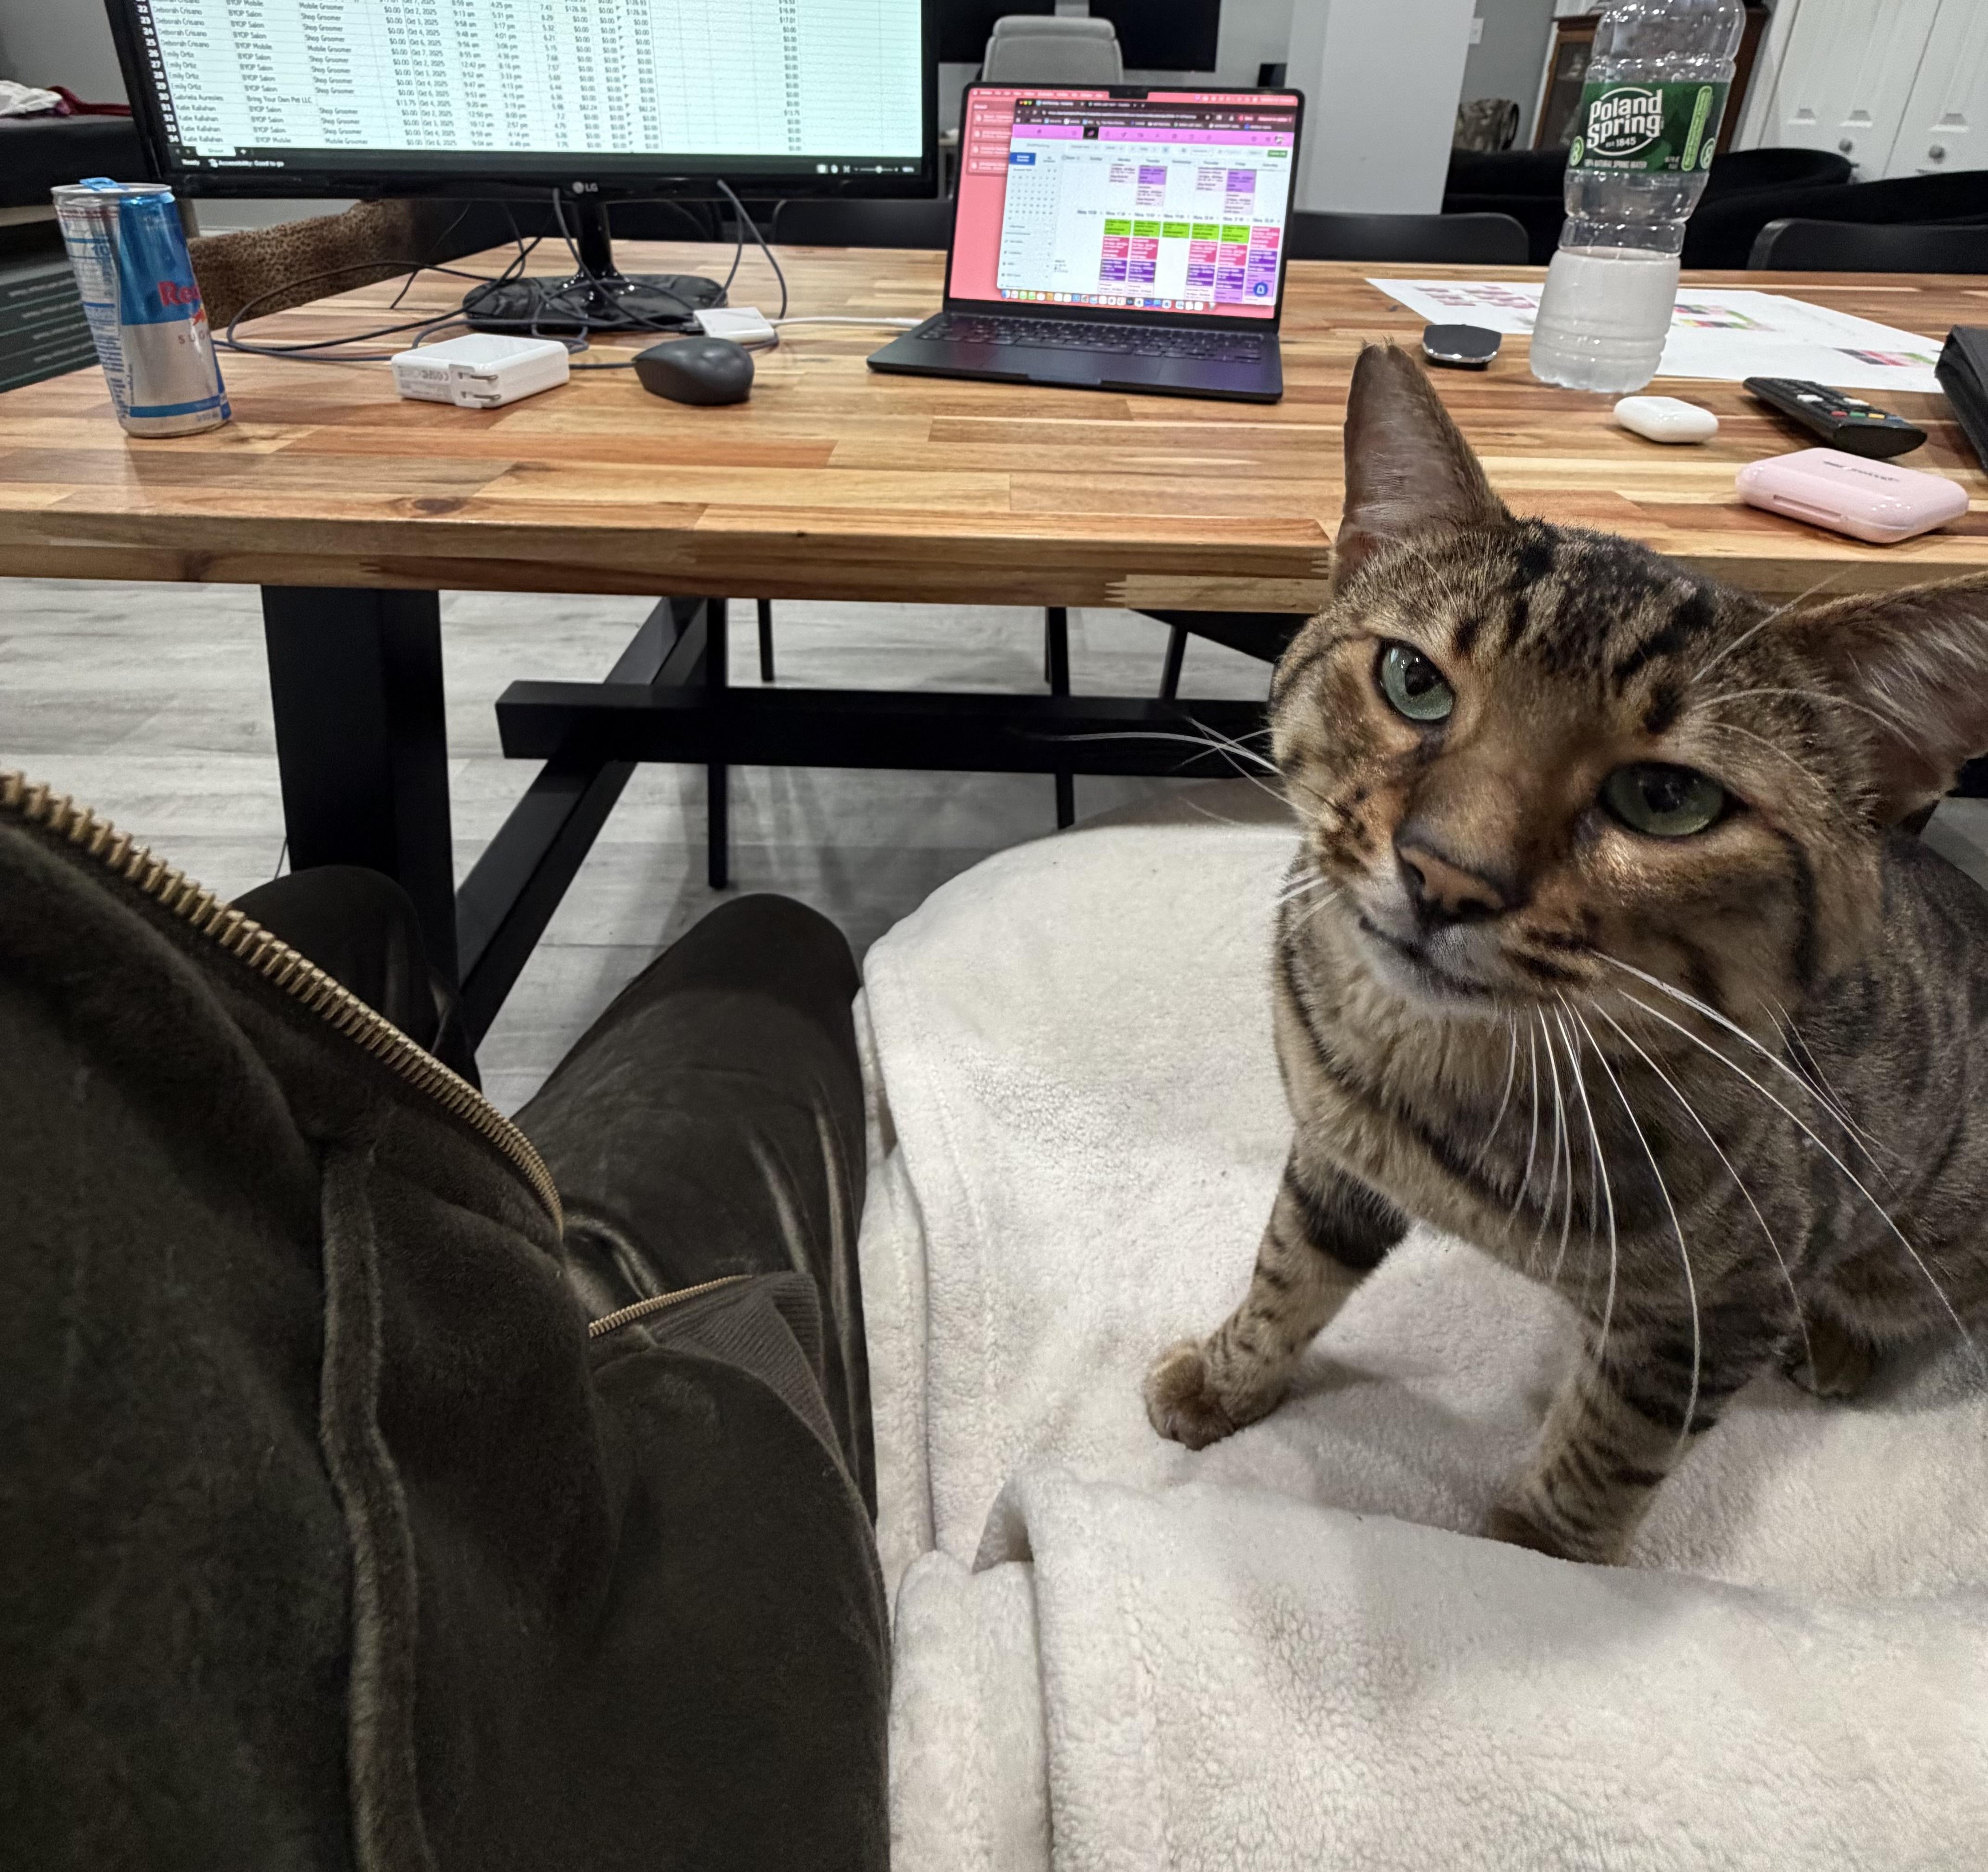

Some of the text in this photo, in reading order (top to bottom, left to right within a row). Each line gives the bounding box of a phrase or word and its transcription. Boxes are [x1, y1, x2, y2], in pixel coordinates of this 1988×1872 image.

[140, 16, 151, 24] 23
[142, 27, 154, 35] 24
[1589, 89, 1663, 125] Poland
[1586, 115, 1661, 148] Spring
[1616, 137, 1636, 147] 1845
[585, 182, 598, 192] LG
